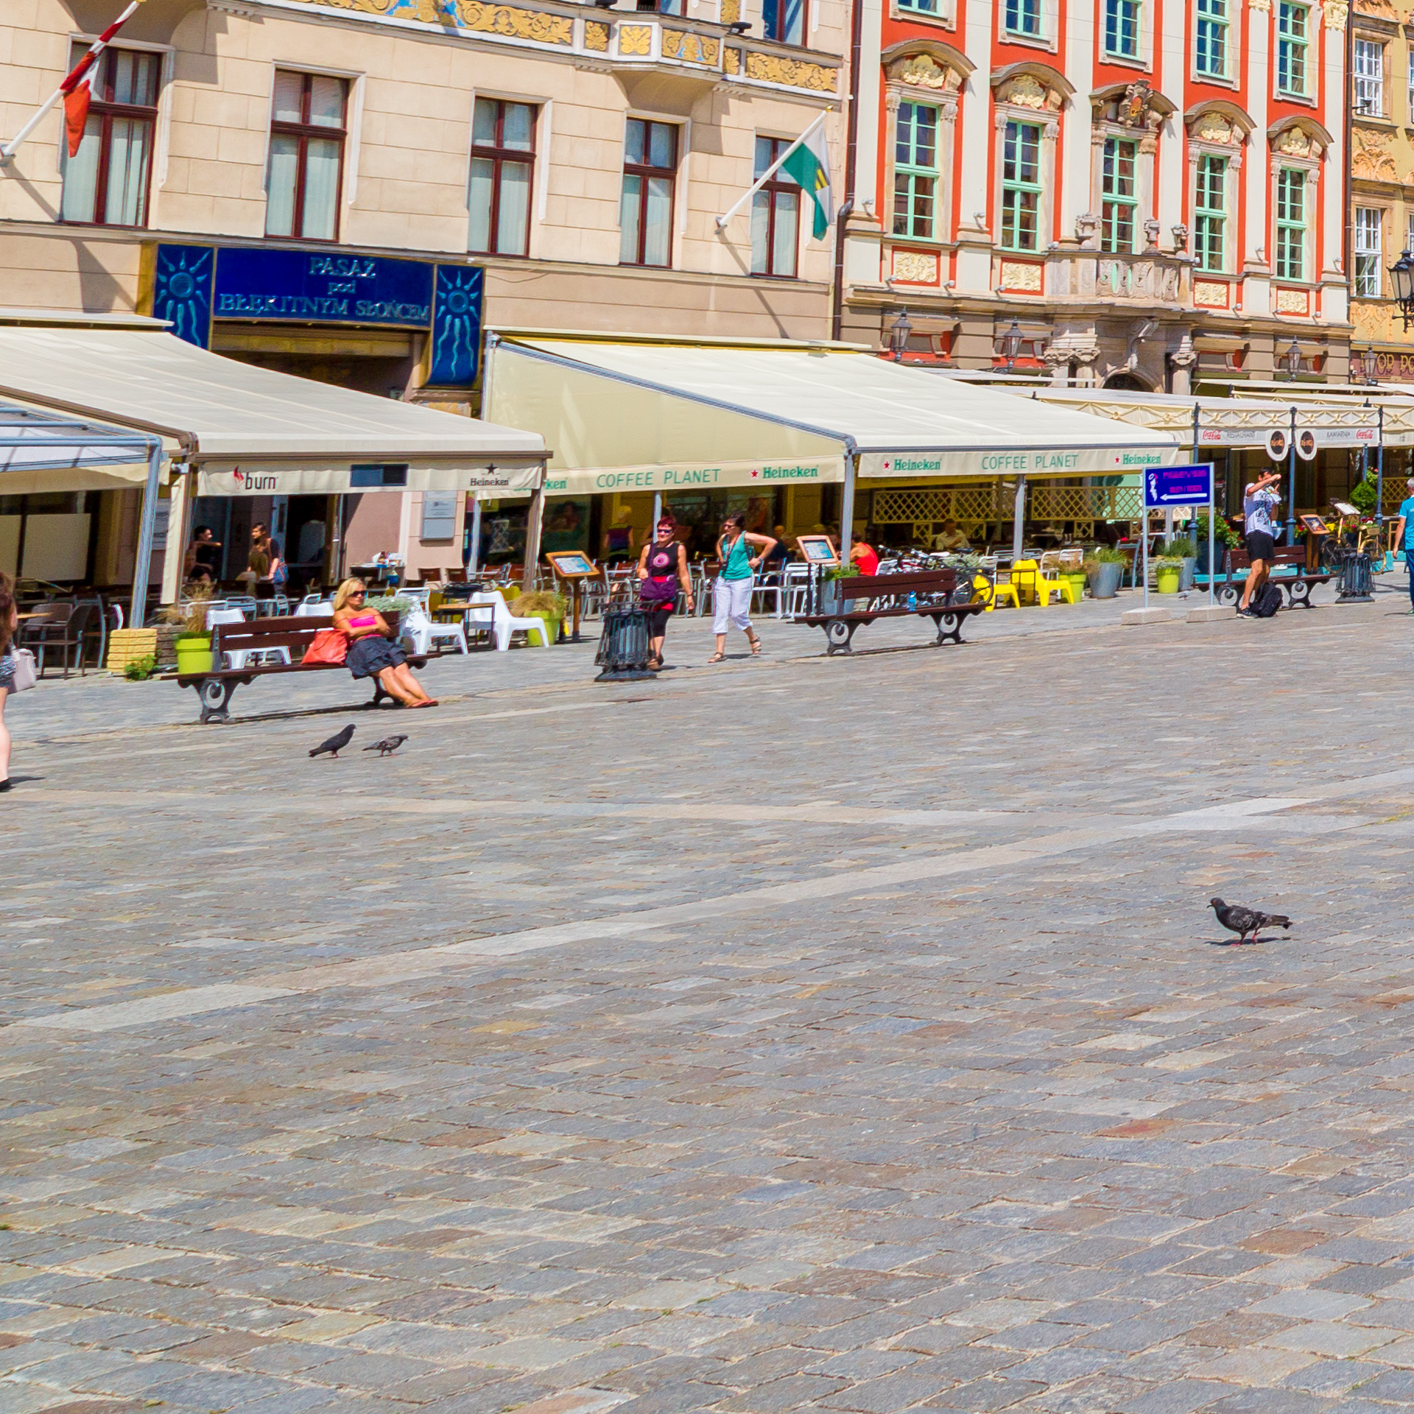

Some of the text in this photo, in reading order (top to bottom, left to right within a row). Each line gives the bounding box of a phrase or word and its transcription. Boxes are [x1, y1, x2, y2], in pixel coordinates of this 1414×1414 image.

[309, 257, 376, 278] PASAŻ
[327, 280, 356, 294] pod
[219, 293, 349, 315] BŁĘKITNYM
[1360, 352, 1395, 370] DÓR
[893, 453, 1161, 471] Heineken COFFEE PLANET Heineken
[245, 472, 276, 490] burn
[470, 477, 509, 486] Heineken
[596, 465, 818, 488] COFFEE PLANET Heineken
